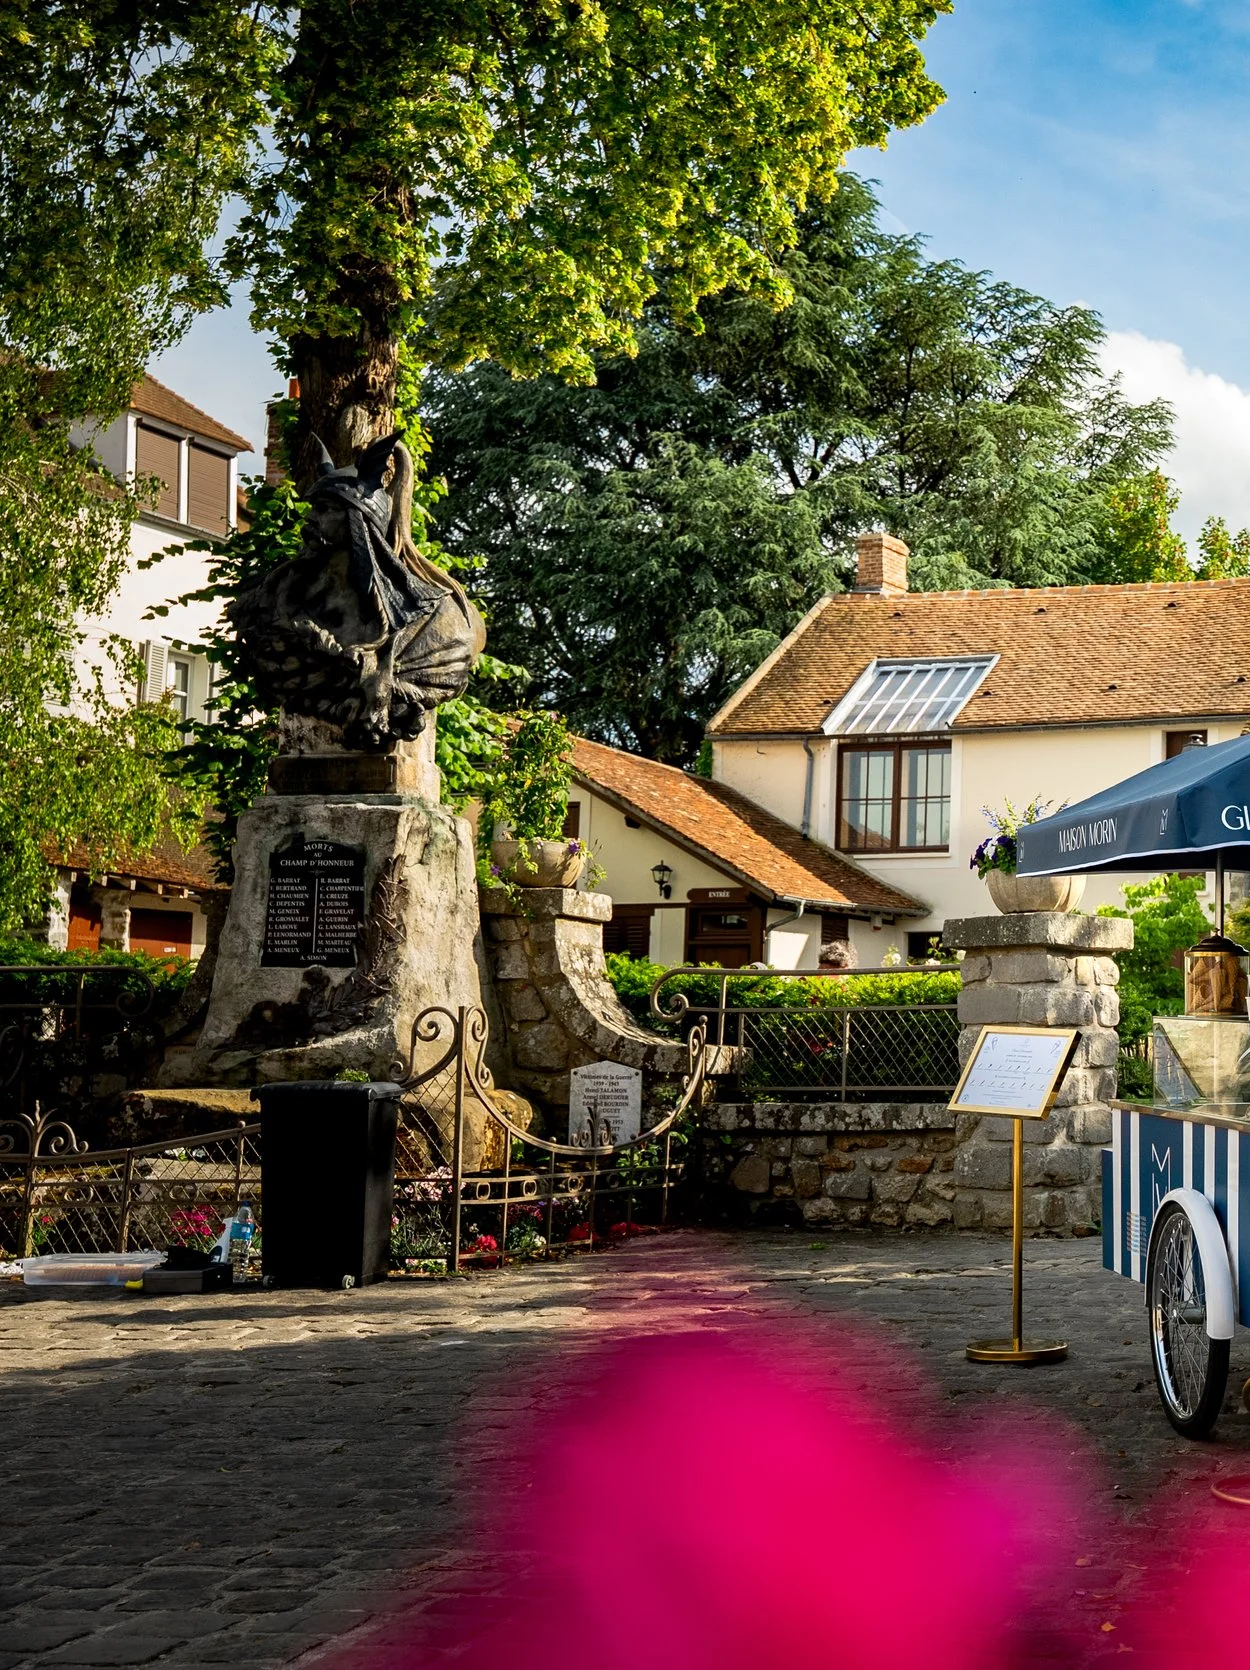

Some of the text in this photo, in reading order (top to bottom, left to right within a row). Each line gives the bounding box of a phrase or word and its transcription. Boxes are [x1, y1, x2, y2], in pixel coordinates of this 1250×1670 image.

[1058, 825, 1087, 853] MAISON
[1088, 817, 1118, 847] MORIN
[303, 843, 334, 852] MORTS
[708, 890, 730, 898] ENTRÉE
